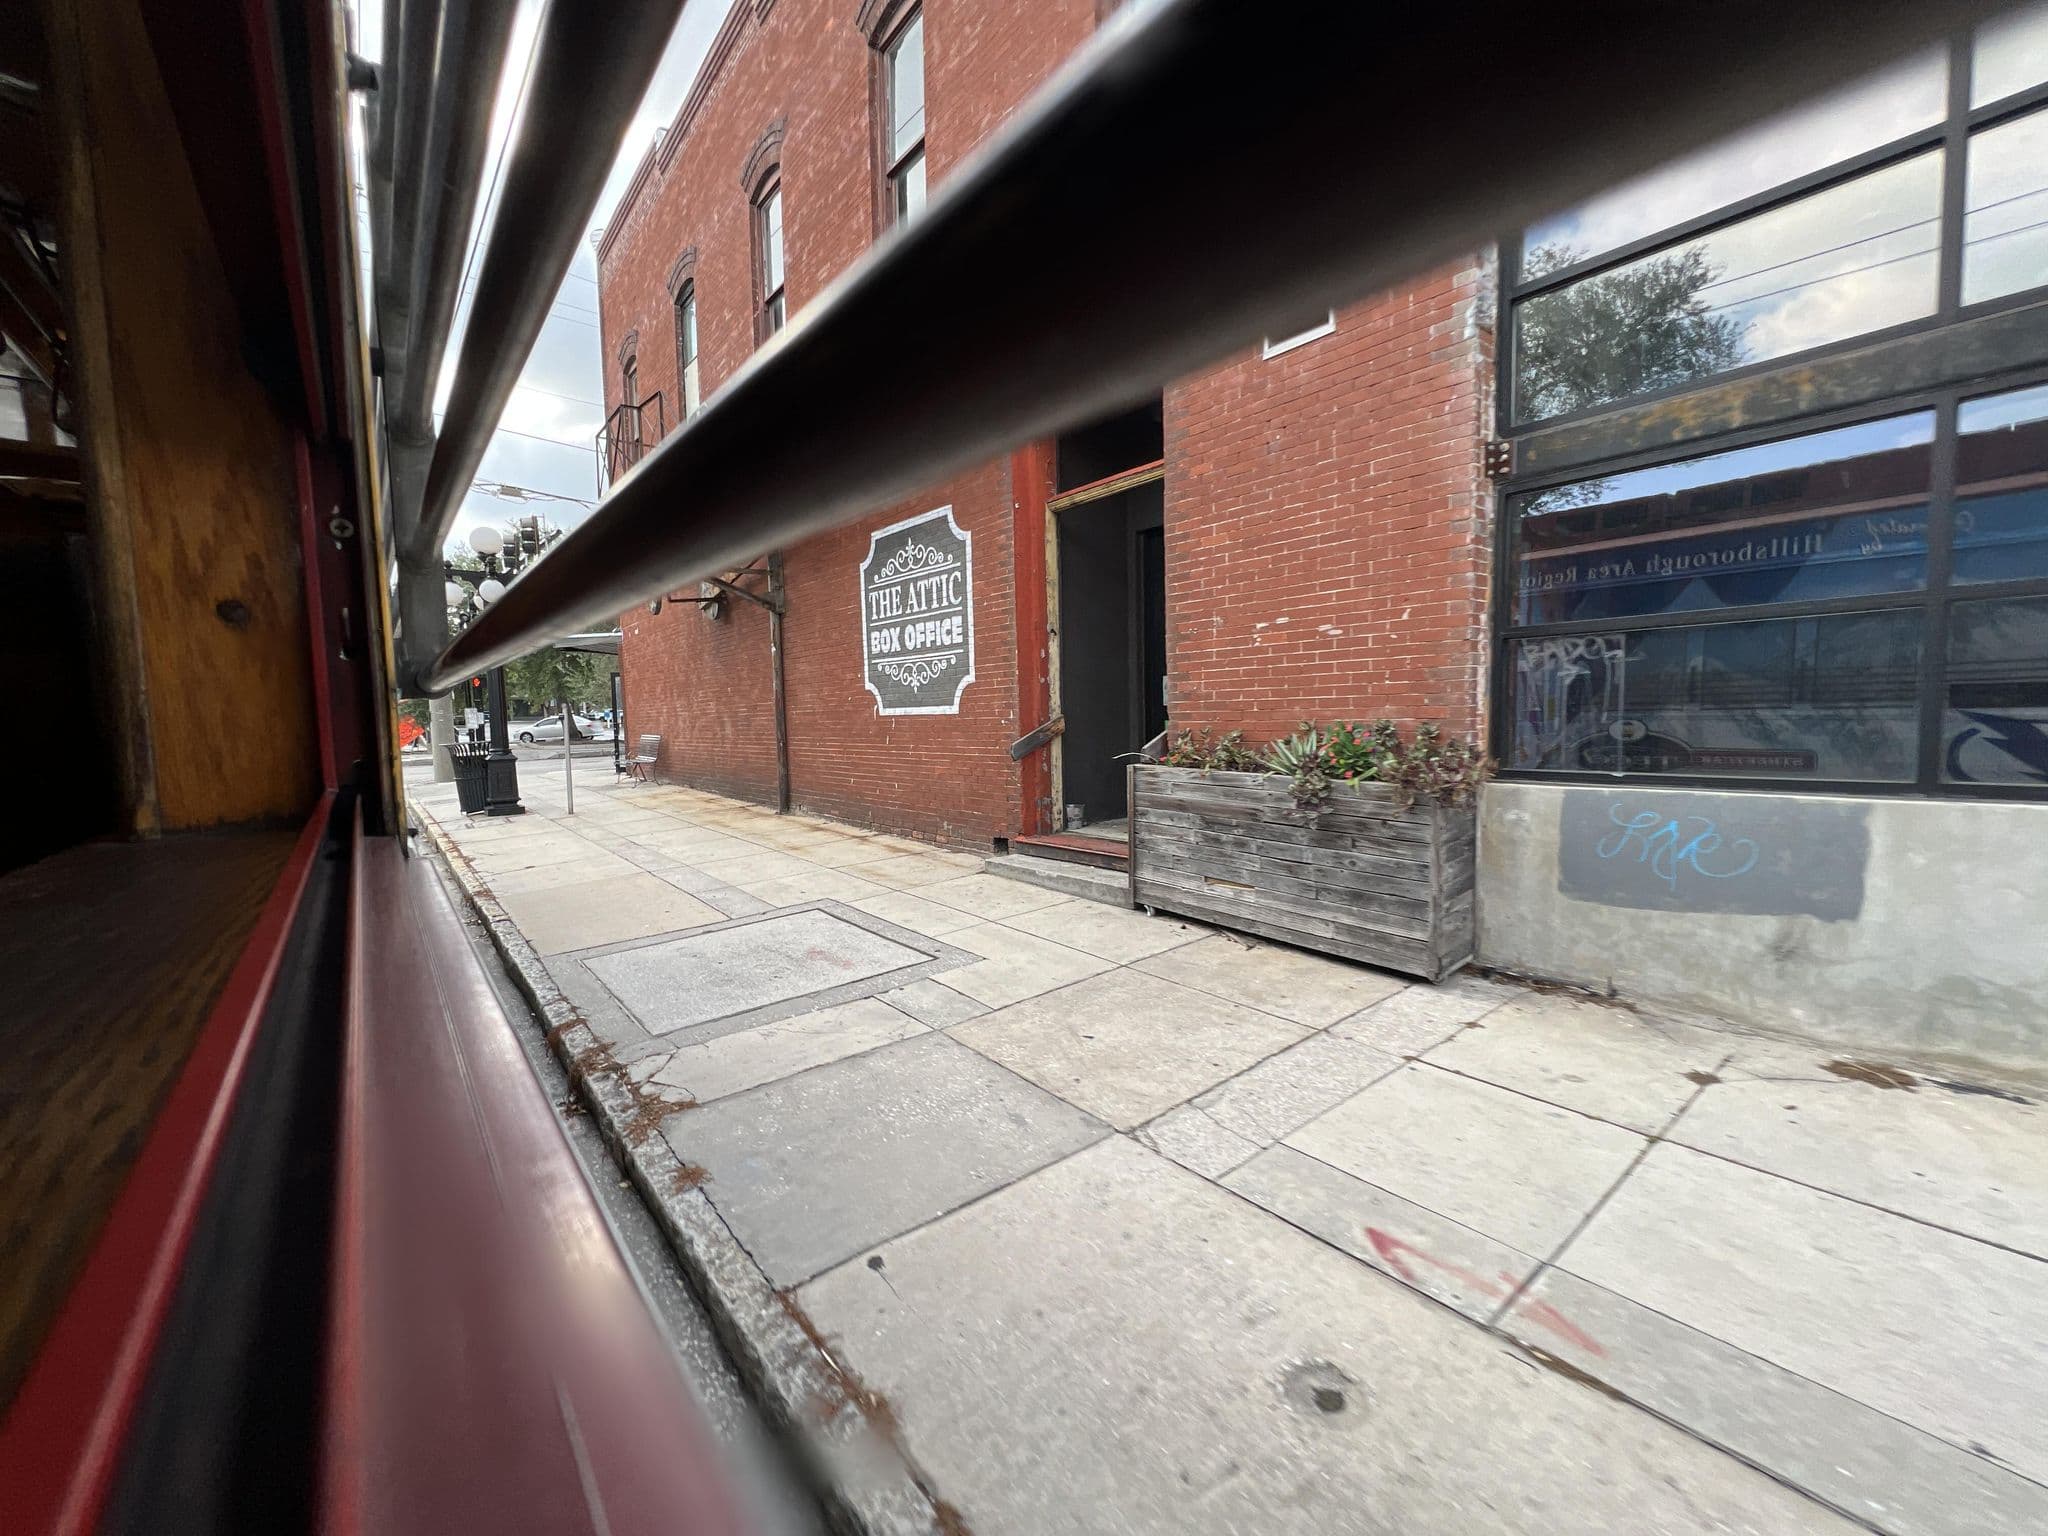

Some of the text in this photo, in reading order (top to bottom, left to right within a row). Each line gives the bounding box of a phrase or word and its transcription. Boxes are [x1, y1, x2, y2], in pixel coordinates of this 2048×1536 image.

[868, 571, 962, 620] THE ATTIC
[871, 616, 963, 654] BOX OFFICE
